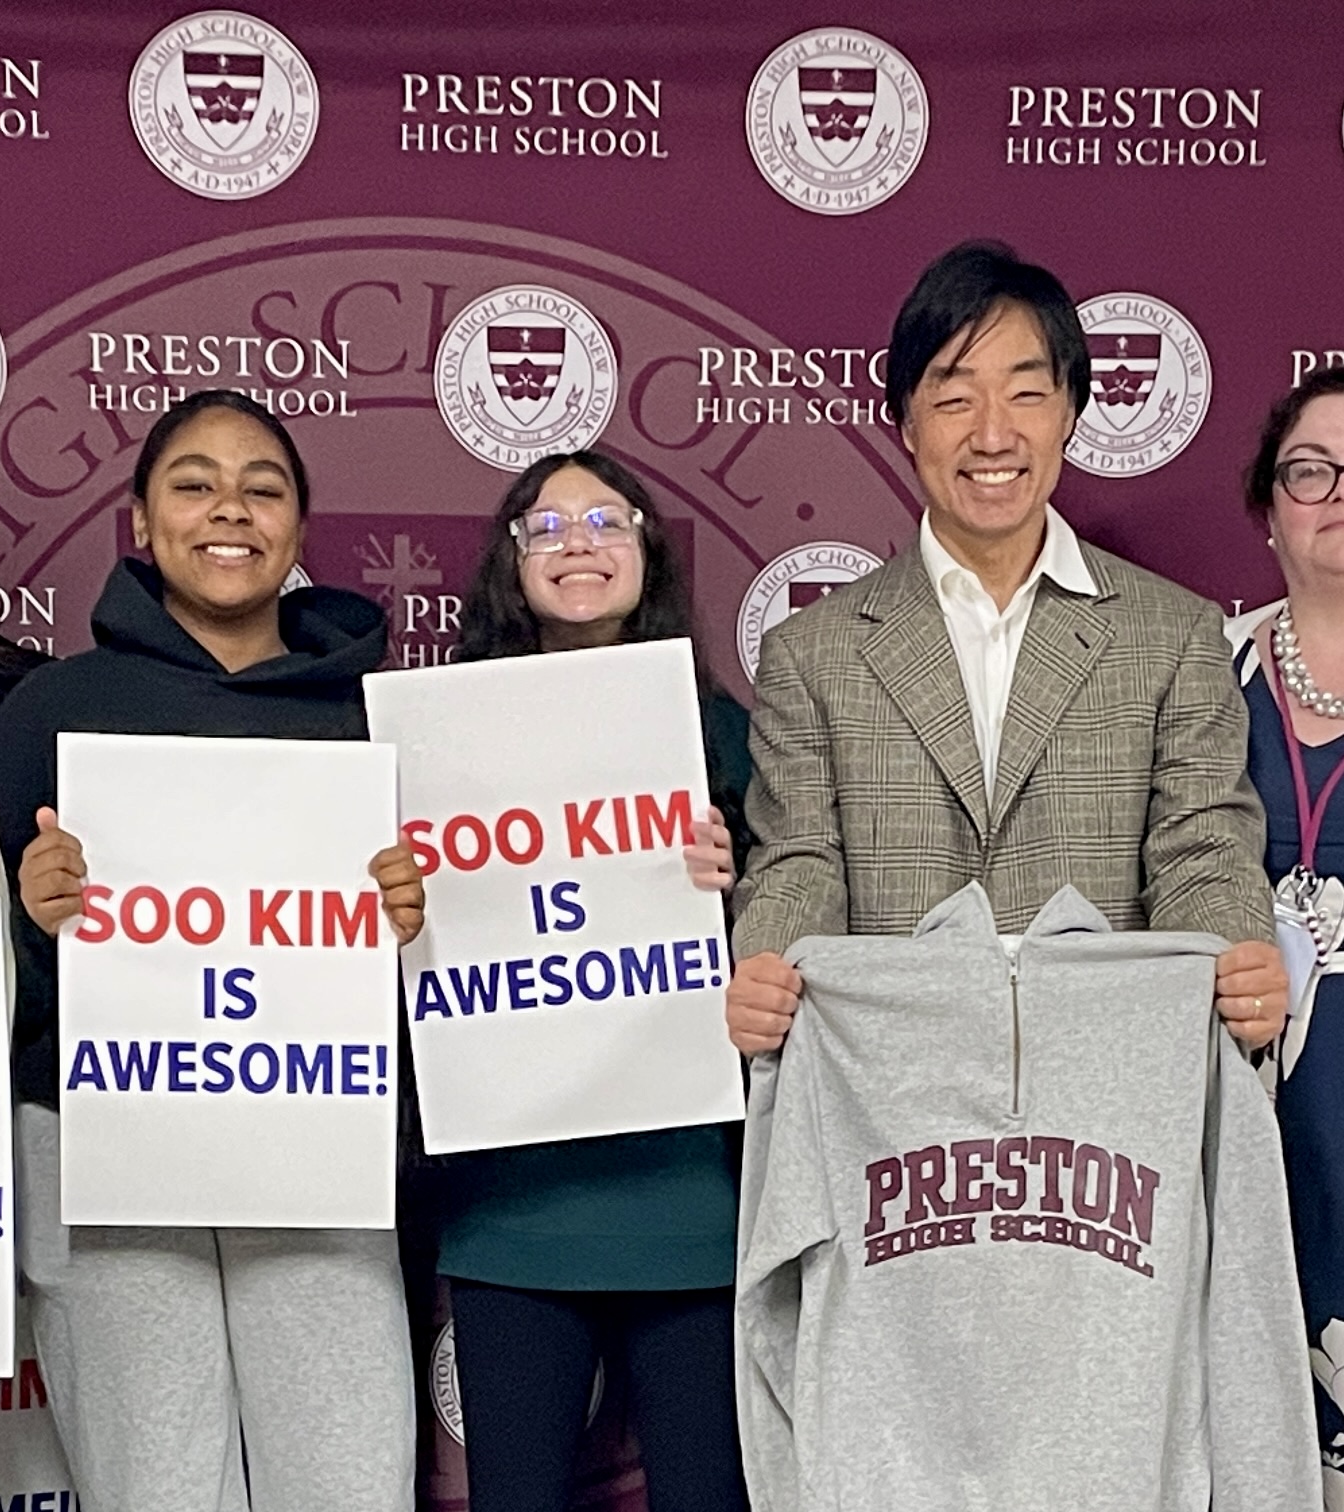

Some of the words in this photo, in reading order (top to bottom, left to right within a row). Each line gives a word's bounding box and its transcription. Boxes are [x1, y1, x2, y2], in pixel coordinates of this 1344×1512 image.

[402, 74, 662, 118] PRESTON
[1008, 86, 1262, 129] PRESTON
[401, 123, 498, 153] HIGH
[515, 127, 669, 158] SCHOOL
[1006, 137, 1100, 165] HIGH
[1116, 139, 1267, 167] SCHOOL
[88, 332, 351, 380] PRESTON
[697, 347, 889, 389] PRESTO
[88, 384, 187, 413] HIGH
[696, 397, 791, 425] HIGH
[806, 550, 870, 574] SCHOO
[399, 808, 544, 876] SOO
[564, 790, 695, 858] KIM
[74, 886, 225, 945] SOO
[249, 889, 379, 948] KIM
[530, 881, 586, 934] IS
[203, 967, 257, 1020] IS
[414, 938, 721, 1021] AWESOME!
[67, 1040, 388, 1096] AWESOME!
[864, 1136, 1160, 1245] PRESTON
[864, 1216, 976, 1267] HIGH
[990, 1214, 1155, 1279] SCHOOL
